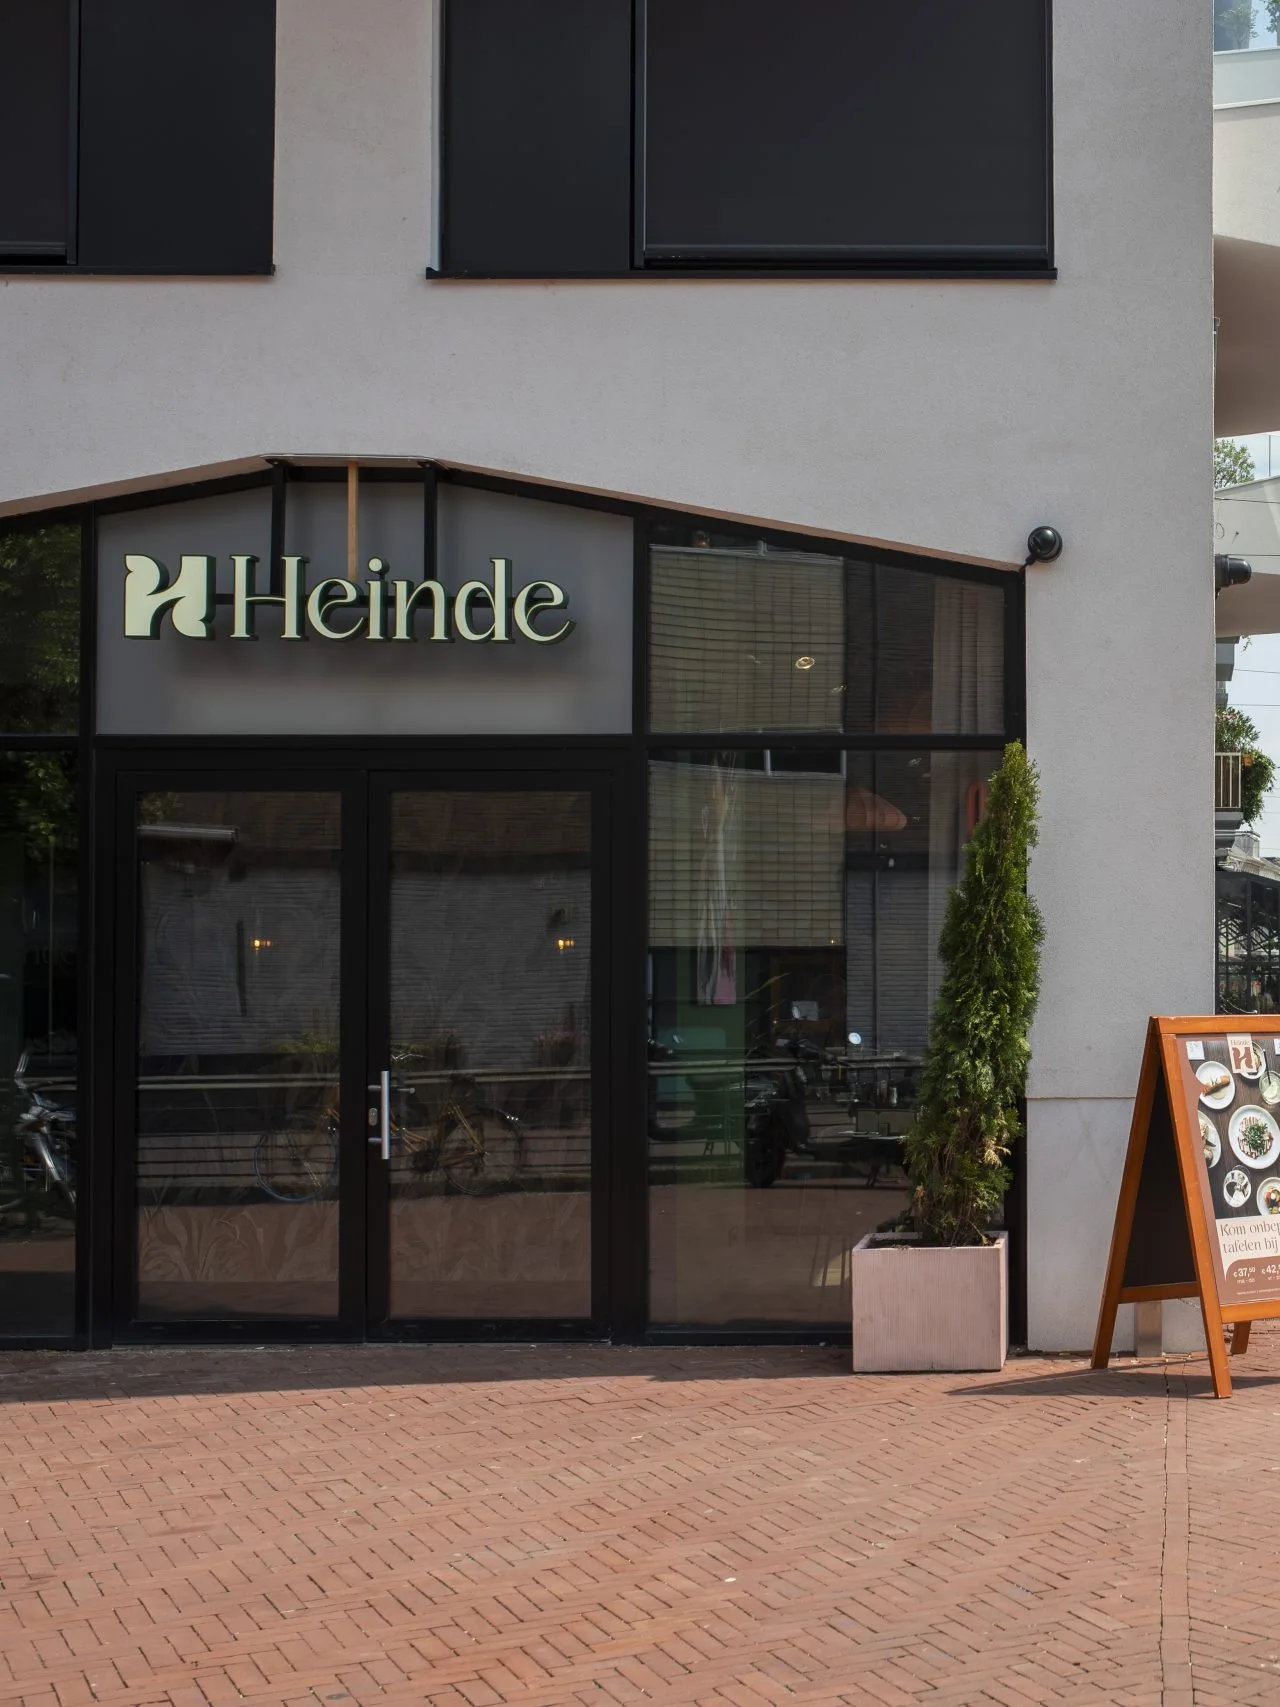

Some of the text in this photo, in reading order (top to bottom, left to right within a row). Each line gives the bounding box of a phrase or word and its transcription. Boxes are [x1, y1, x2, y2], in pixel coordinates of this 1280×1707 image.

[229, 555, 577, 645] Heinde
[1220, 1223, 1246, 1236] Kom
[1222, 1238, 1261, 1253] tafelen
[1264, 1236, 1279, 1253] bij
